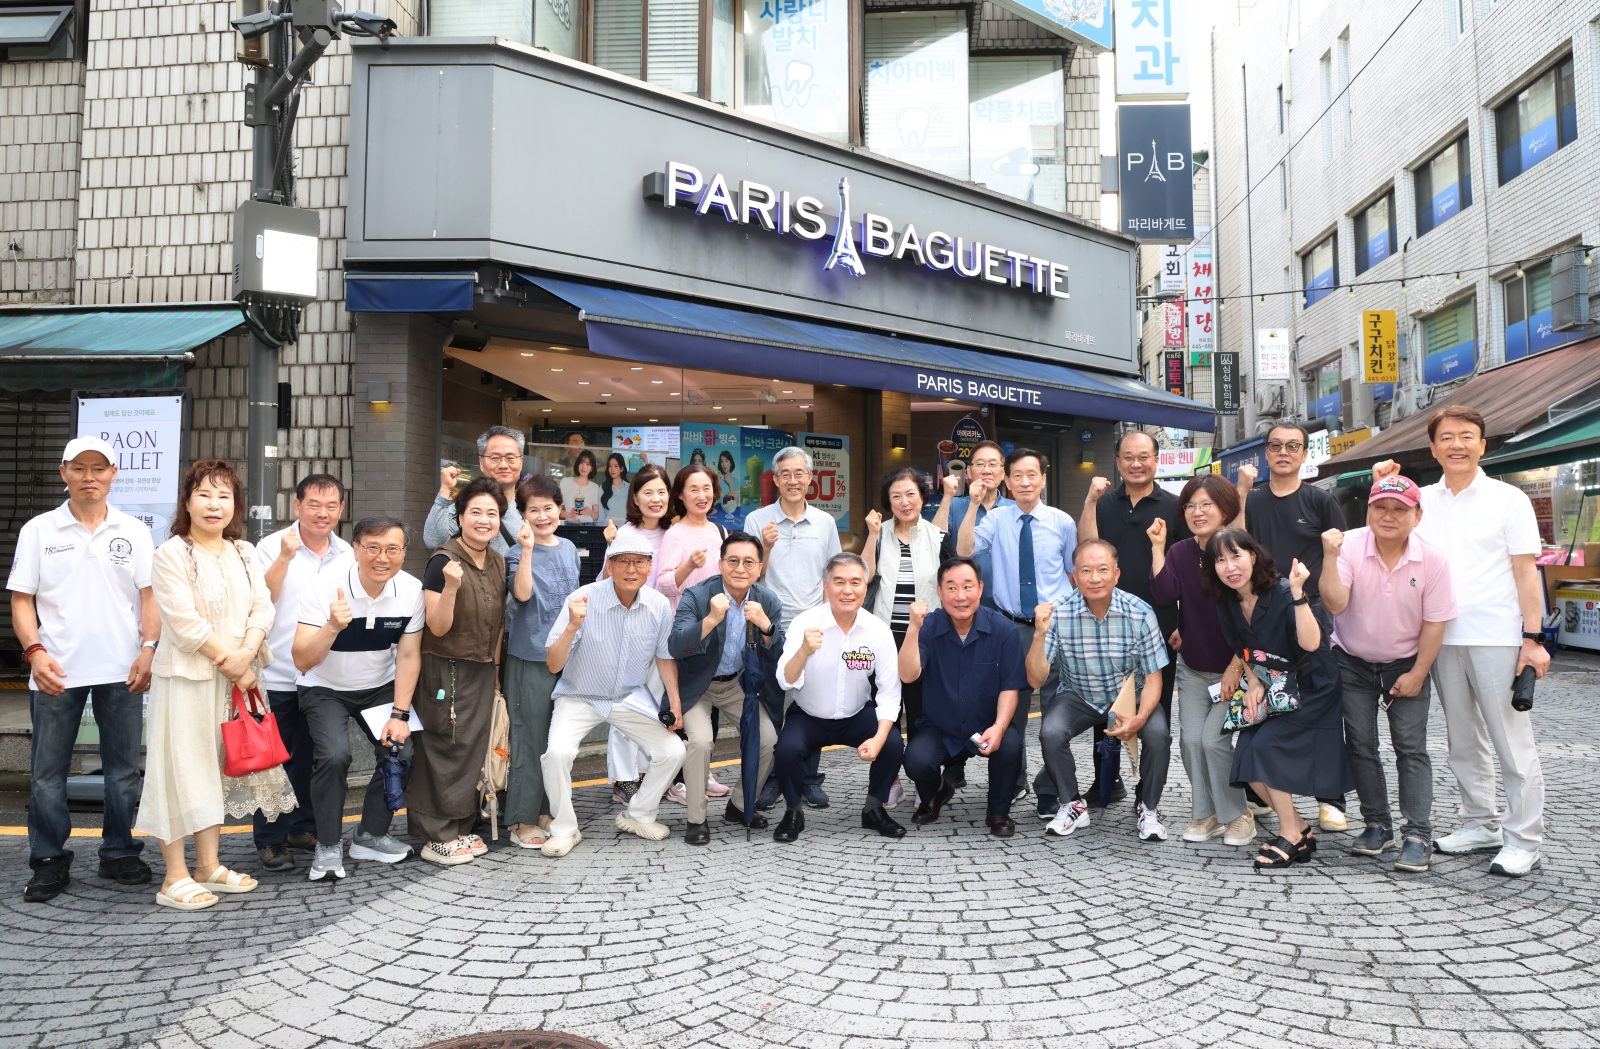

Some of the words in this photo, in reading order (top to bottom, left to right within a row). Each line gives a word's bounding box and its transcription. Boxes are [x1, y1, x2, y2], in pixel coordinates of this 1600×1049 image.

[772, 25, 818, 52] 발치
[1131, 0, 1180, 86] 치과
[870, 59, 956, 84] 치아미백
[976, 100, 1056, 122] 약물치료
[663, 160, 828, 240] PARIS
[861, 211, 1070, 300] BAGUETTE
[1127, 217, 1187, 232] 파리바게뜨
[1064, 329, 1097, 346] 파리바게뜨
[1368, 313, 1384, 374] 구구치킨
[1386, 339, 1397, 372] 닭강정
[1168, 359, 1182, 385] 토토
[916, 372, 964, 395] PARIS
[967, 380, 1042, 406] BAGUETTE
[682, 430, 703, 443] 파바
[718, 433, 738, 446] 빙수
[744, 435, 765, 450] 파바
[956, 429, 982, 438] 아메리카노
[118, 451, 164, 471] LLET
[812, 450, 821, 460] kt
[958, 447, 973, 458] 20
[1160, 452, 1176, 465] 이용
[1178, 451, 1194, 465] 안내
[846, 660, 871, 670] 김현기
